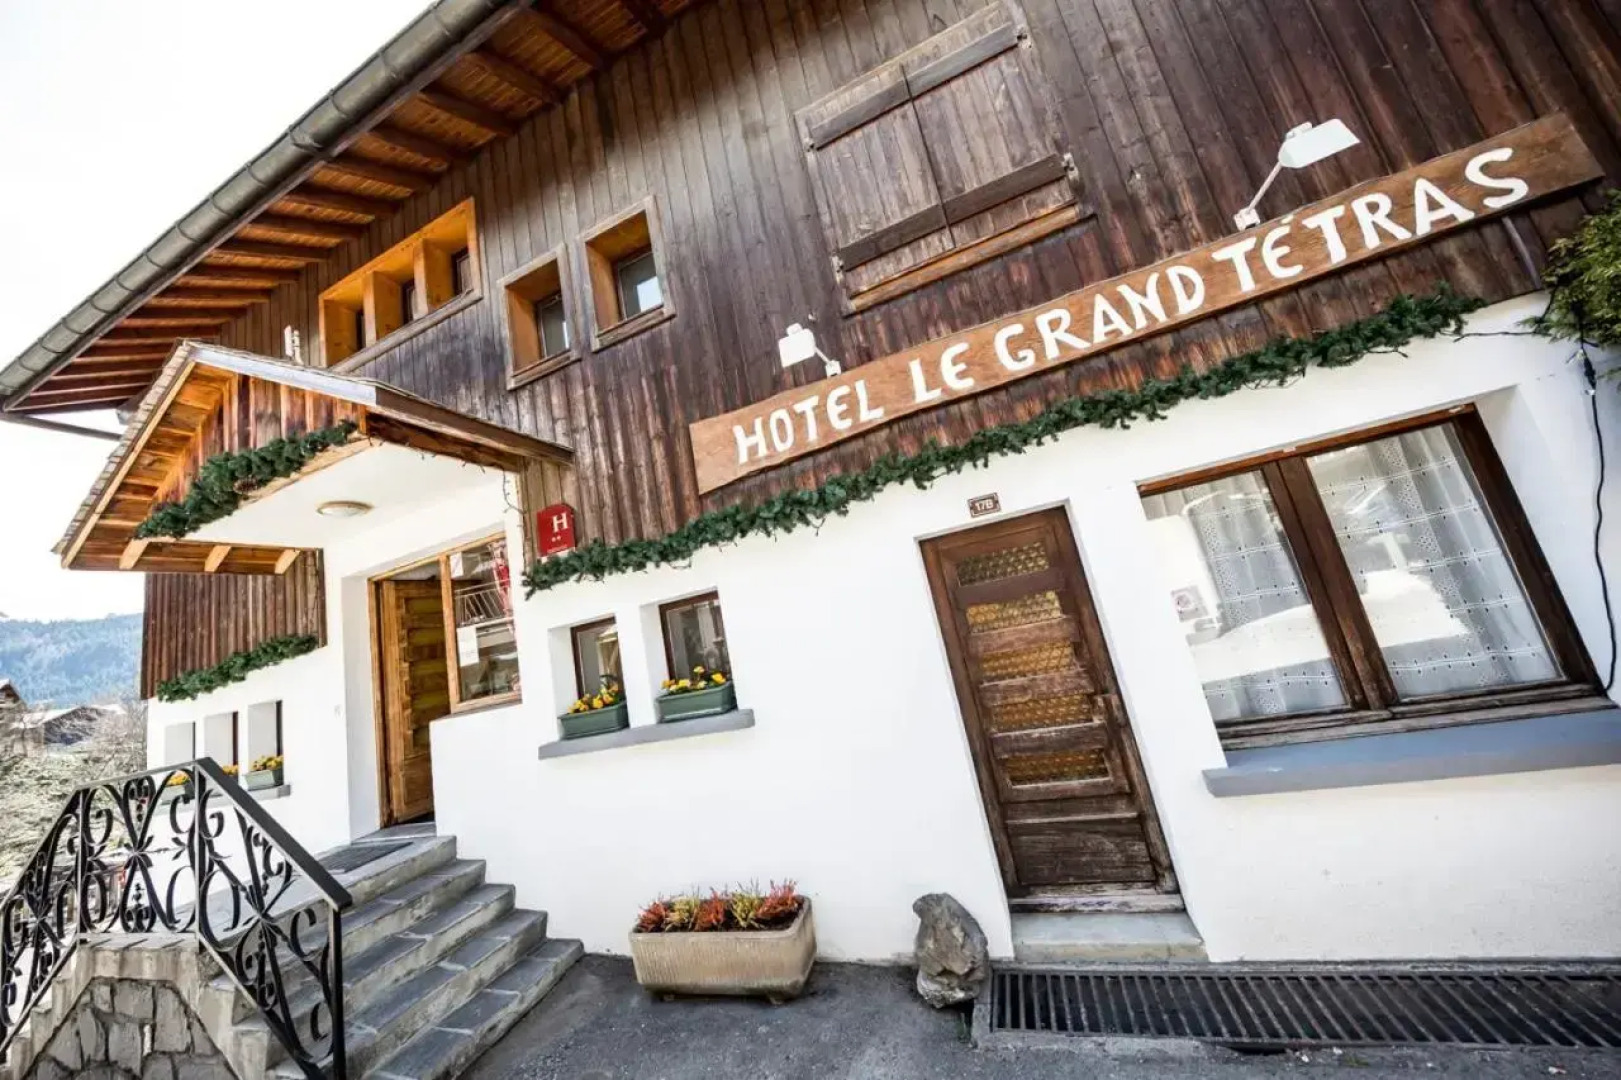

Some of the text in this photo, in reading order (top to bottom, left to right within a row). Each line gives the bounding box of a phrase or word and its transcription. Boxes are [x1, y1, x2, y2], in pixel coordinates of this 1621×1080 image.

[733, 147, 1529, 463] HOTEL LE GRAND TÉTRAS
[552, 512, 568, 533] H
